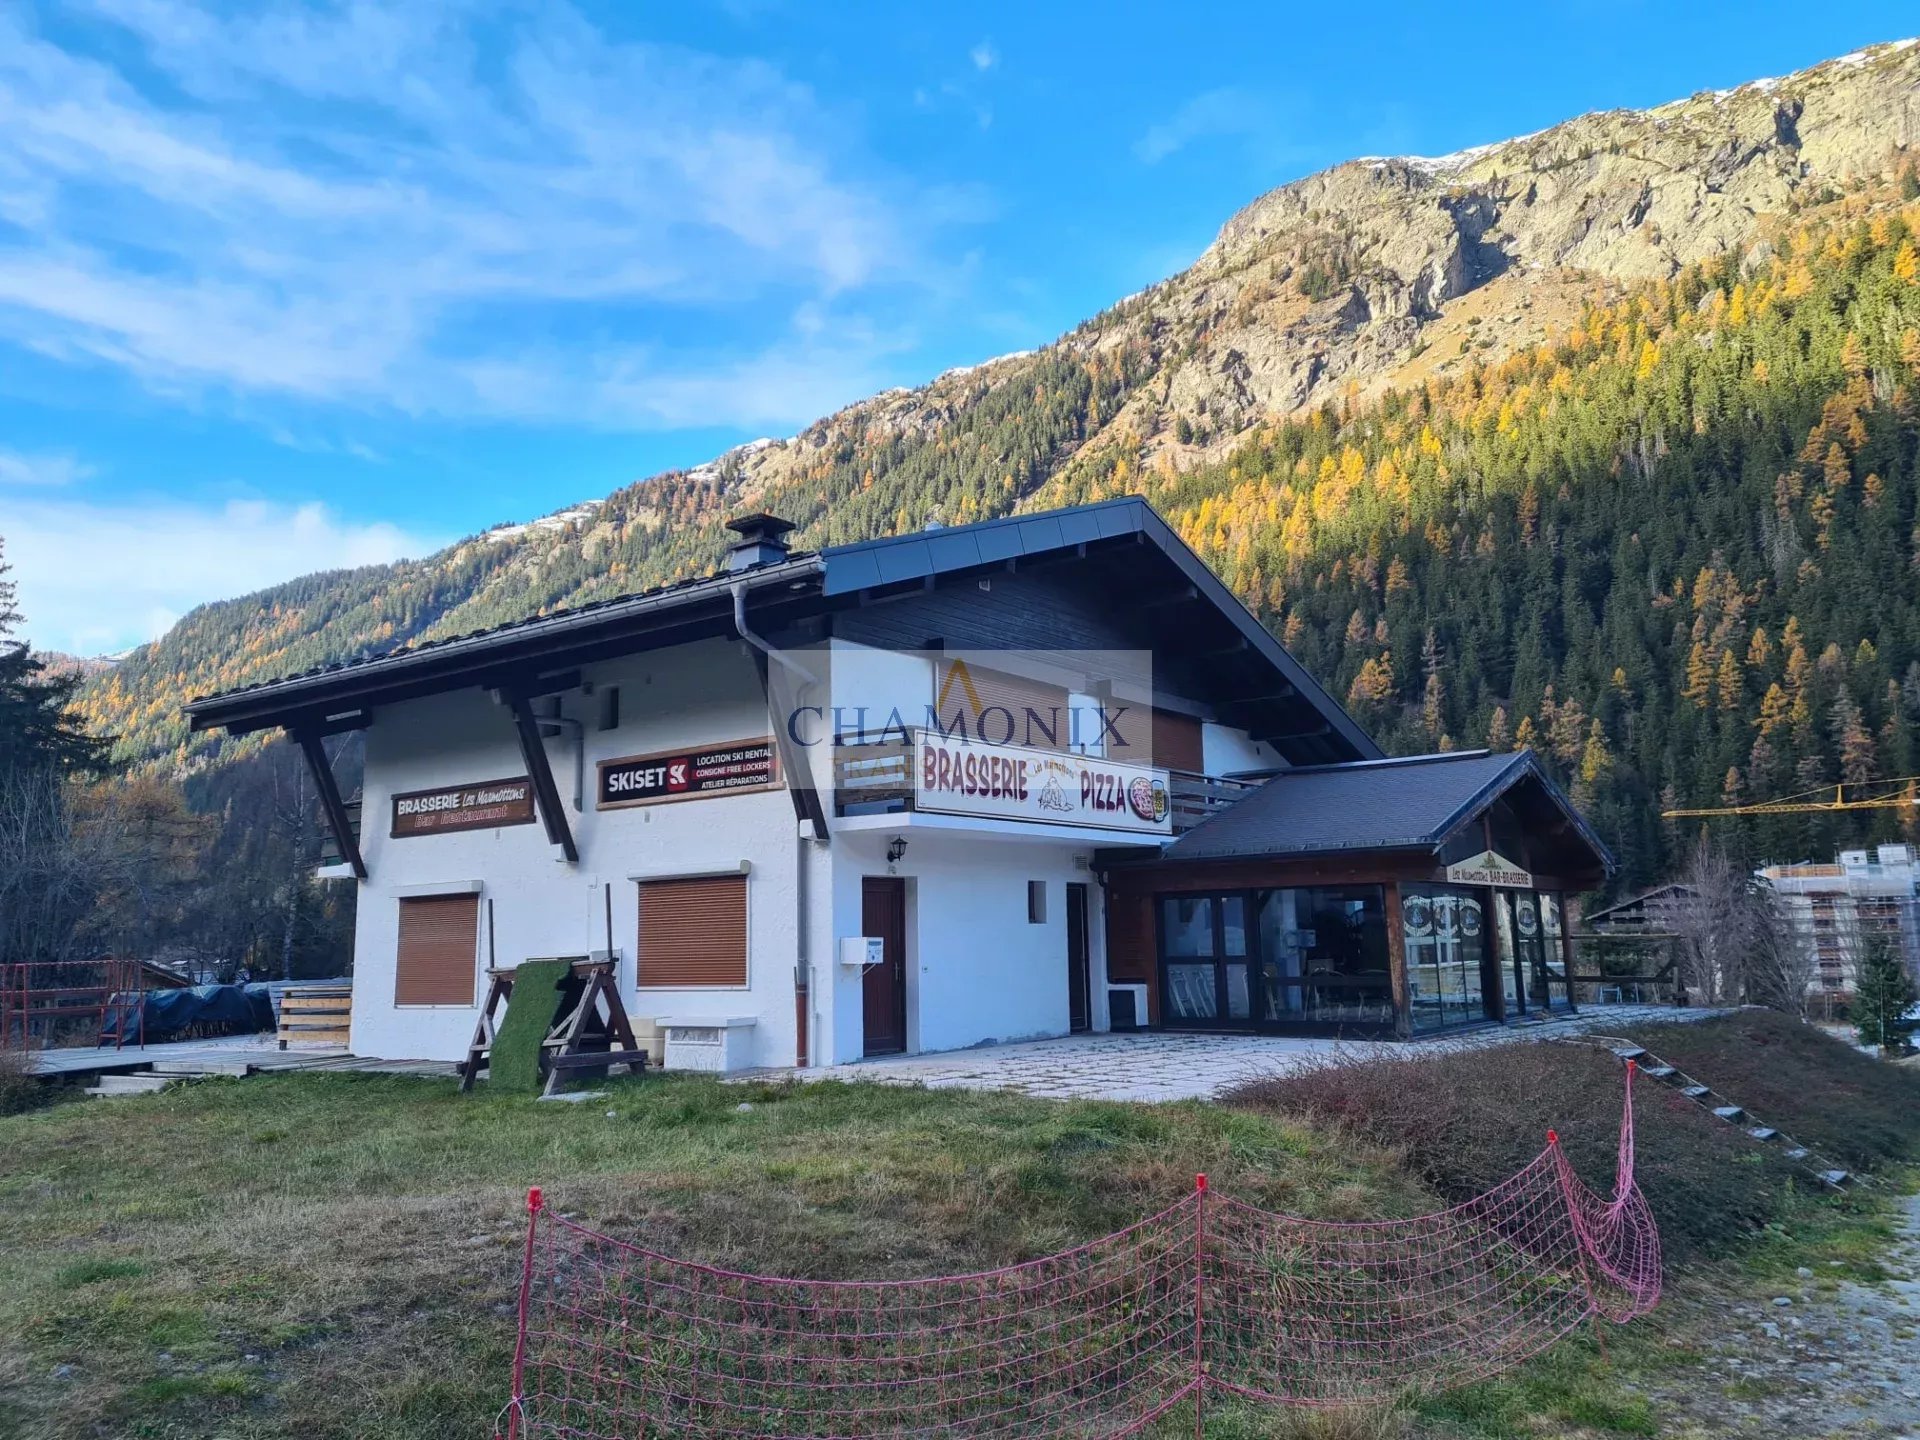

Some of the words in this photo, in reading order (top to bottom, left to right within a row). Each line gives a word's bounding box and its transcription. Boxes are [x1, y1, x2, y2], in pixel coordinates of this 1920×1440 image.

[697, 754, 731, 766] LOCATION
[732, 752, 743, 761] SKI
[744, 748, 772, 759] RENTAL
[608, 767, 667, 793] SKISET
[695, 766, 726, 778] CONSIGNE
[727, 764, 742, 773] FREE
[743, 760, 771, 772] LOCKERS
[923, 744, 1029, 802] BRASSERIE
[1080, 769, 1127, 814] PIZZA
[701, 780, 725, 790] ATELIER
[726, 774, 768, 787] RÉPARATIONS
[398, 793, 461, 815] BRASSERIE
[462, 792, 476, 807] Les
[414, 814, 435, 828] Bar
[440, 804, 508, 825] Restaurant
